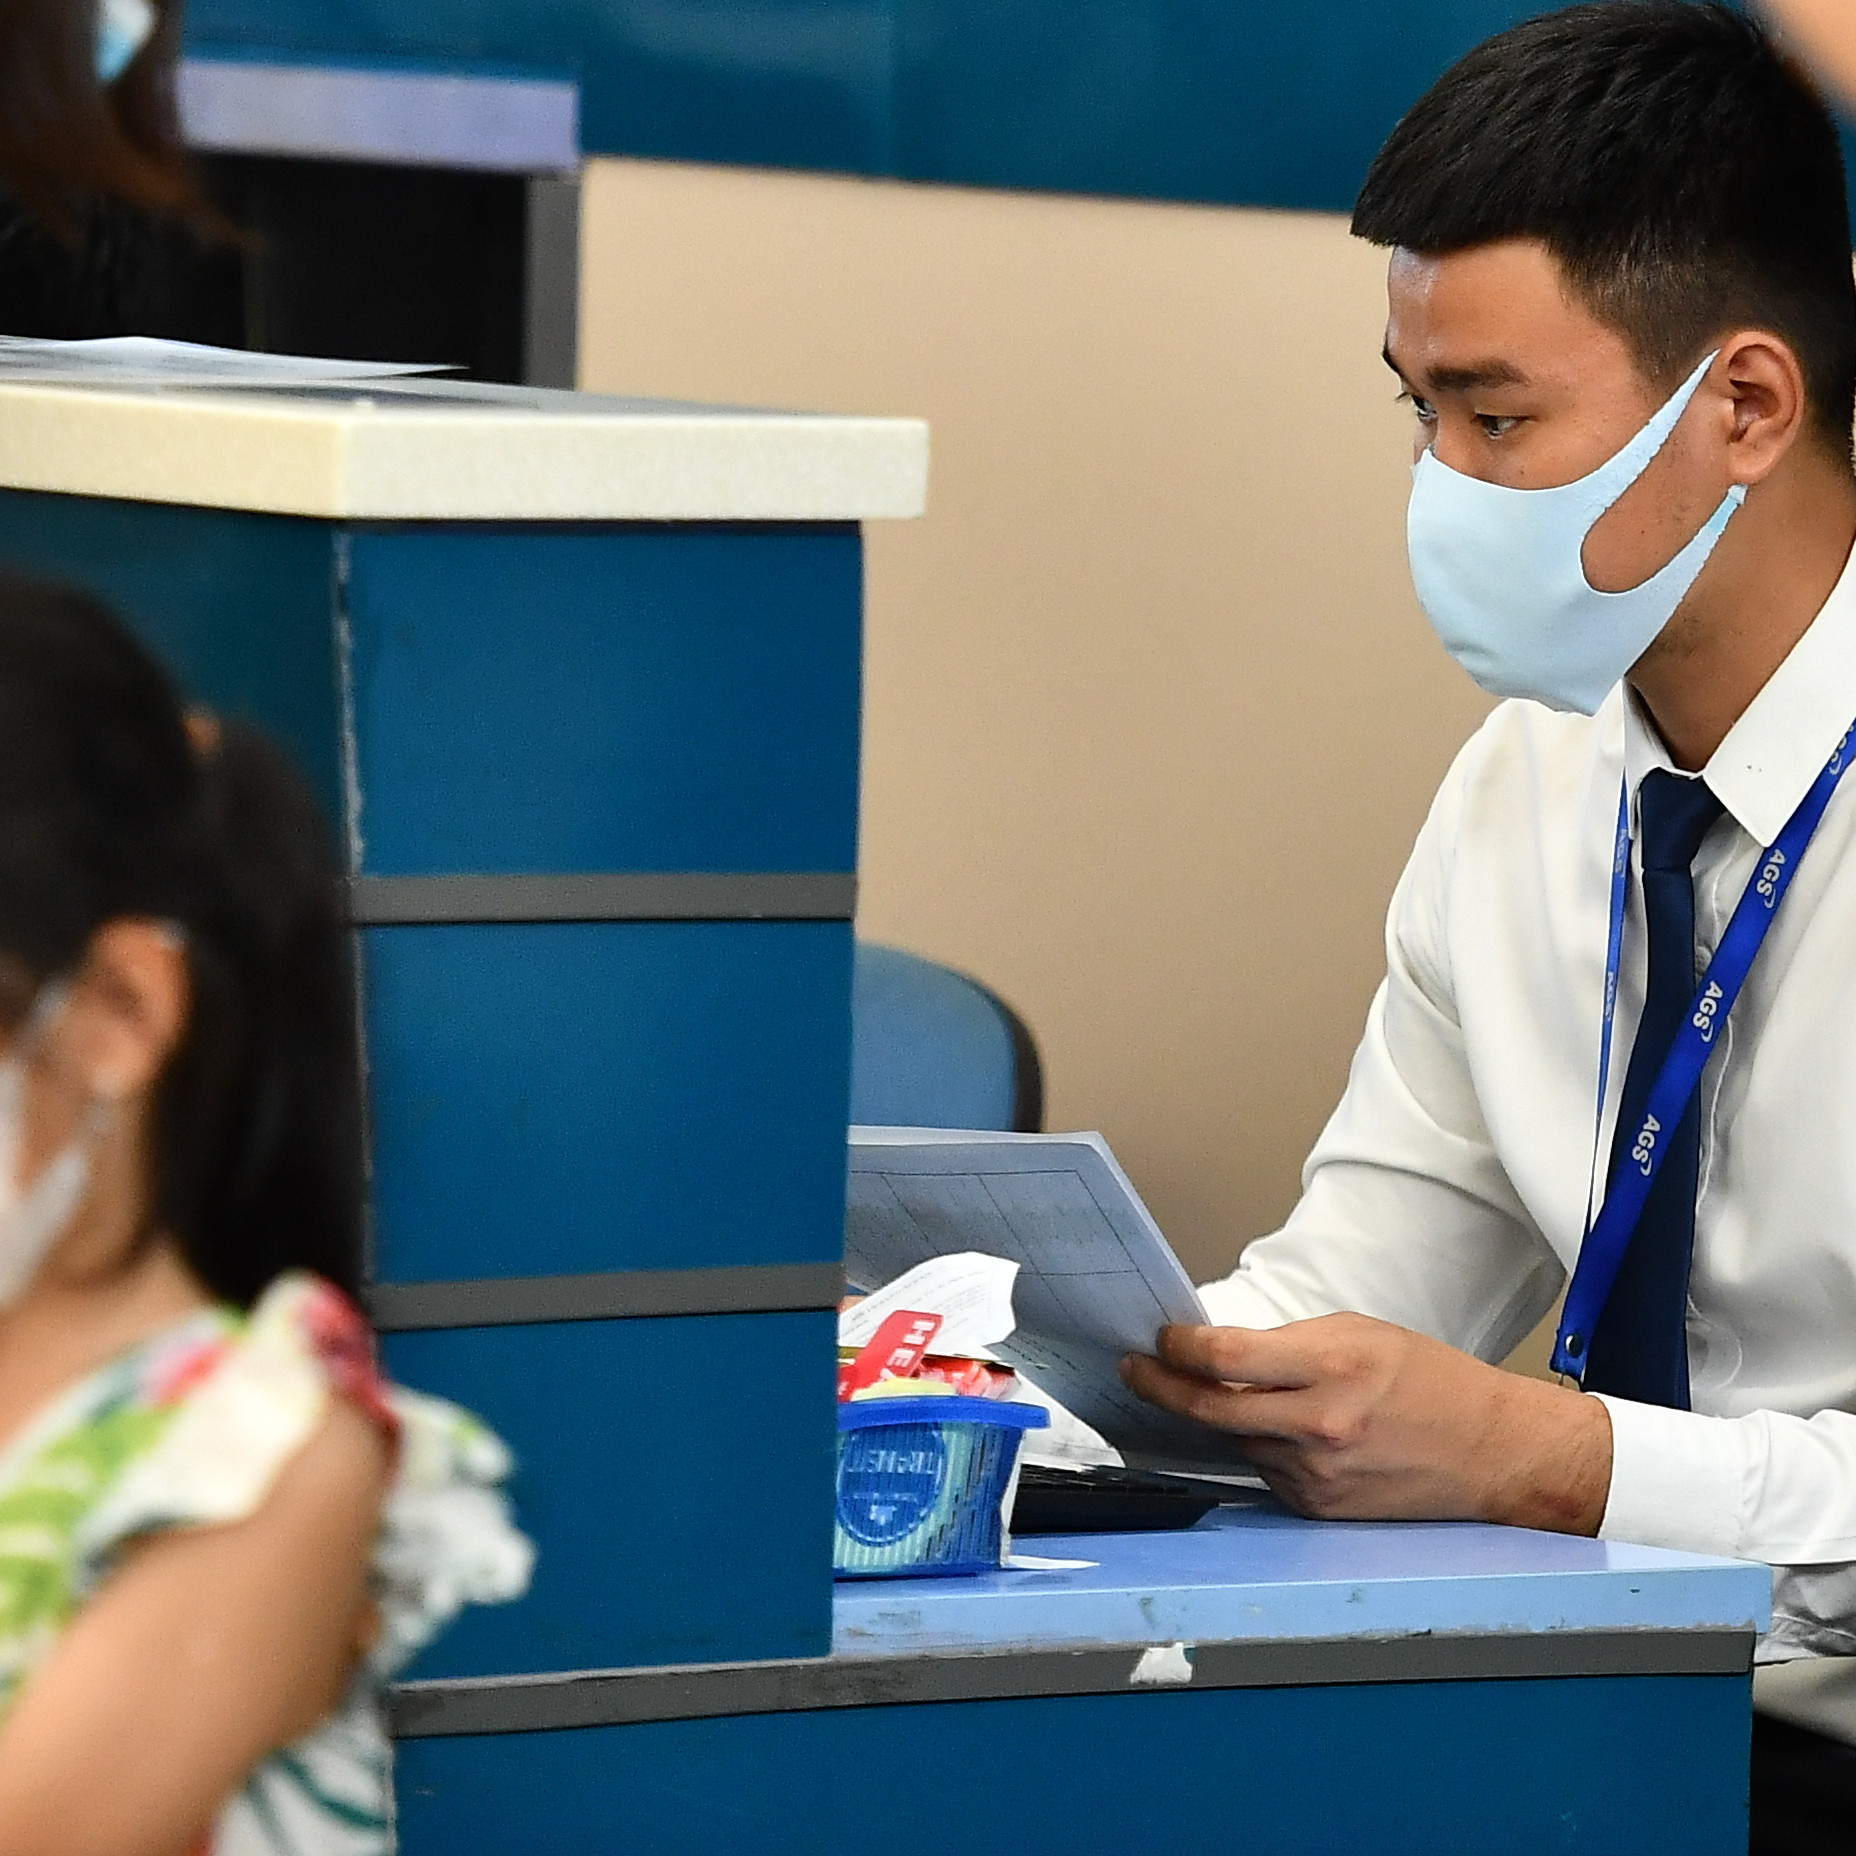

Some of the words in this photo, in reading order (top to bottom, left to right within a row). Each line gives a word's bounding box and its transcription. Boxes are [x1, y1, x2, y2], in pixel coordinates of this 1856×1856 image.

[1756, 848, 1786, 902] AGS
[1692, 980, 1724, 1032] AGS
[1632, 1113, 1662, 1164] AGS
